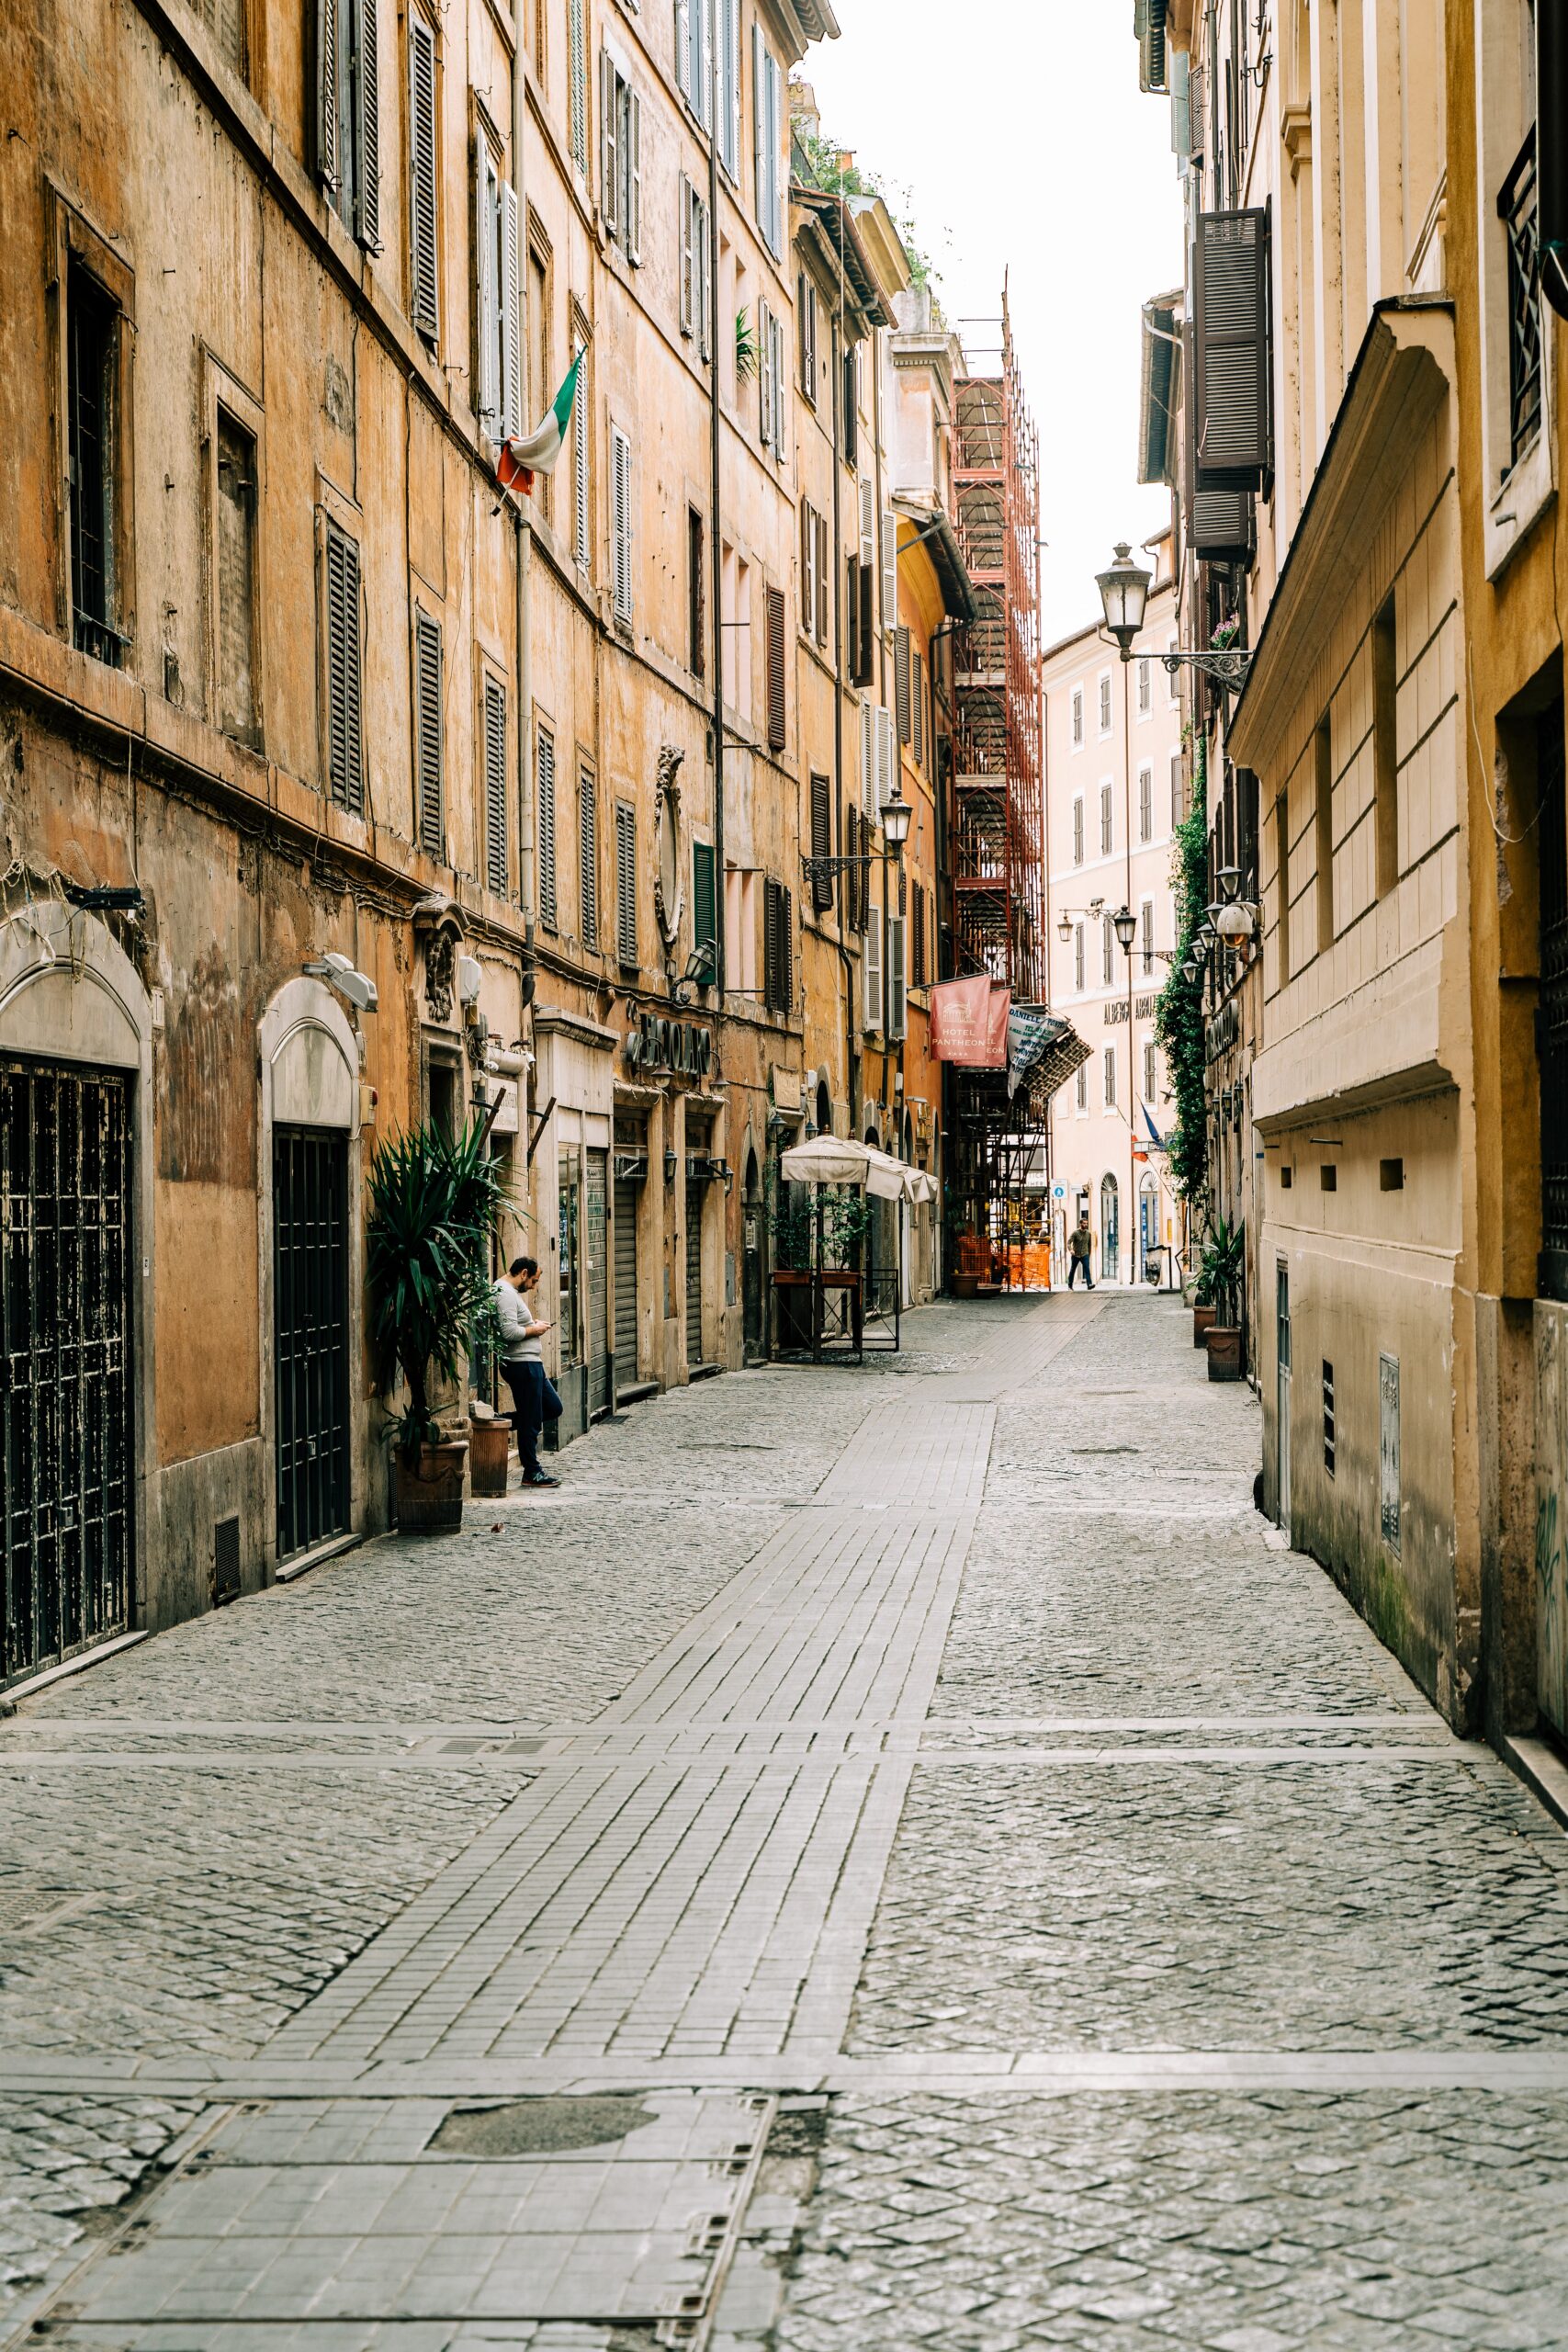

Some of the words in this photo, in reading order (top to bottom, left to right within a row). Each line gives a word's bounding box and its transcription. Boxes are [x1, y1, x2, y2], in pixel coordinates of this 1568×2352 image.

[1009, 1008, 1041, 1023] DANIELE
[942, 1028, 976, 1036] HOTEL
[931, 1038, 986, 1046] PANTHEON
